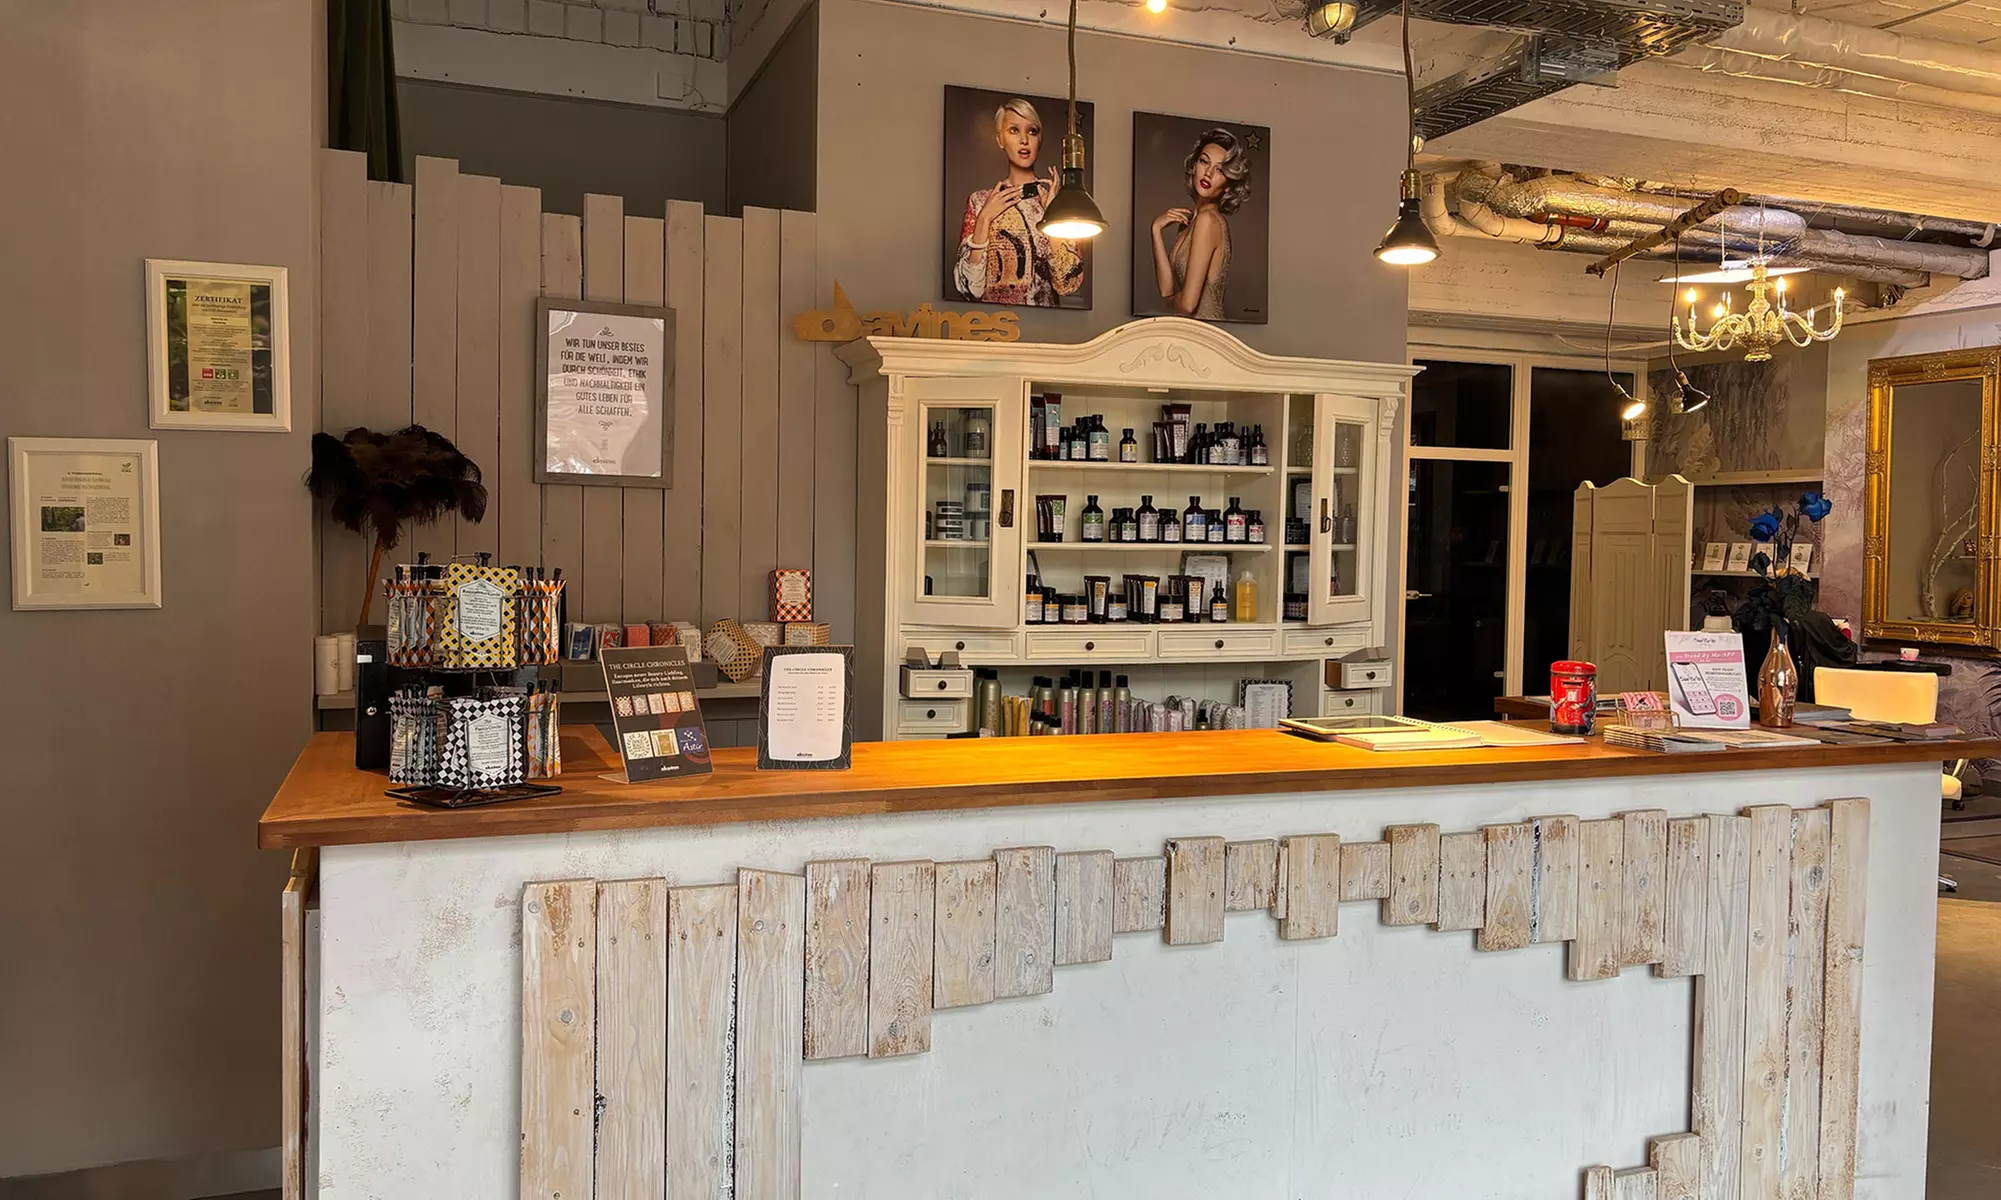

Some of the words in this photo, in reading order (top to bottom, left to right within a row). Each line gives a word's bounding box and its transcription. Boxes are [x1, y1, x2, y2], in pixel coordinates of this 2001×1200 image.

[195, 295, 243, 304] ZERTIFIKAT
[565, 337, 580, 348] WIR
[582, 338, 596, 349] TUN
[597, 340, 620, 351] UNSER
[621, 342, 645, 353] BESTES
[560, 350, 574, 361] FÜR
[575, 352, 586, 361] DIE
[612, 355, 633, 365] INDEM
[634, 356, 649, 366] WIR
[562, 364, 586, 375] DURCH
[628, 368, 647, 379] ETHIK
[579, 378, 633, 391] NACHHALTIGKEIT
[634, 382, 646, 392] EIN
[575, 391, 597, 402] GUTES
[598, 393, 619, 403] LEBEN
[619, 392, 633, 404] FÜR
[578, 404, 594, 415] ALLE
[622, 662, 646, 670] CIRCLE
[646, 660, 686, 668] CHRONICLES
